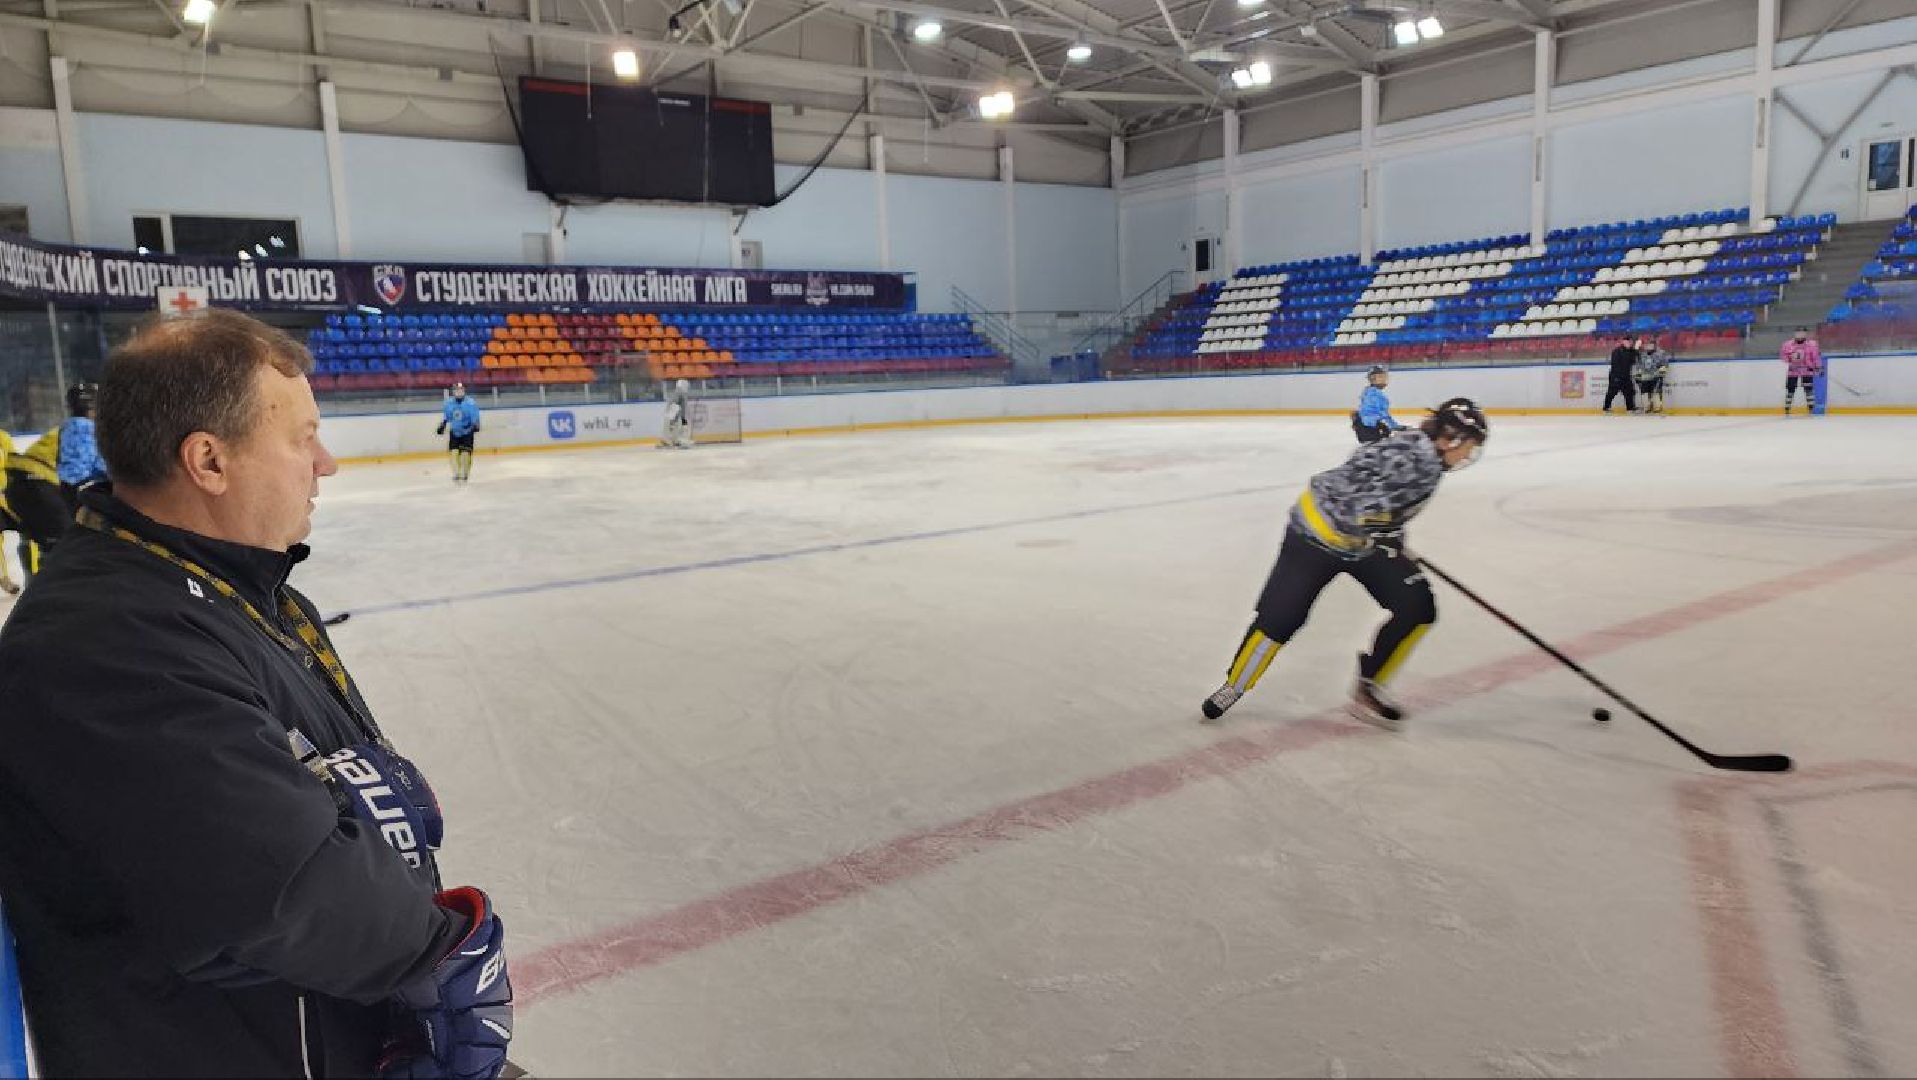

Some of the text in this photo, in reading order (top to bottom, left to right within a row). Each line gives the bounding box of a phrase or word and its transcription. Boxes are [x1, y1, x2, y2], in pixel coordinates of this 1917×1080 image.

[0, 240, 337, 301] ТУДЕНЧЕСКИЙ СПОРТИВНЫЙ СОЮЗ
[415, 269, 747, 305] СТУДЕНЧЕСКАЯ ХОККЕЙНАЯ ЛИГА
